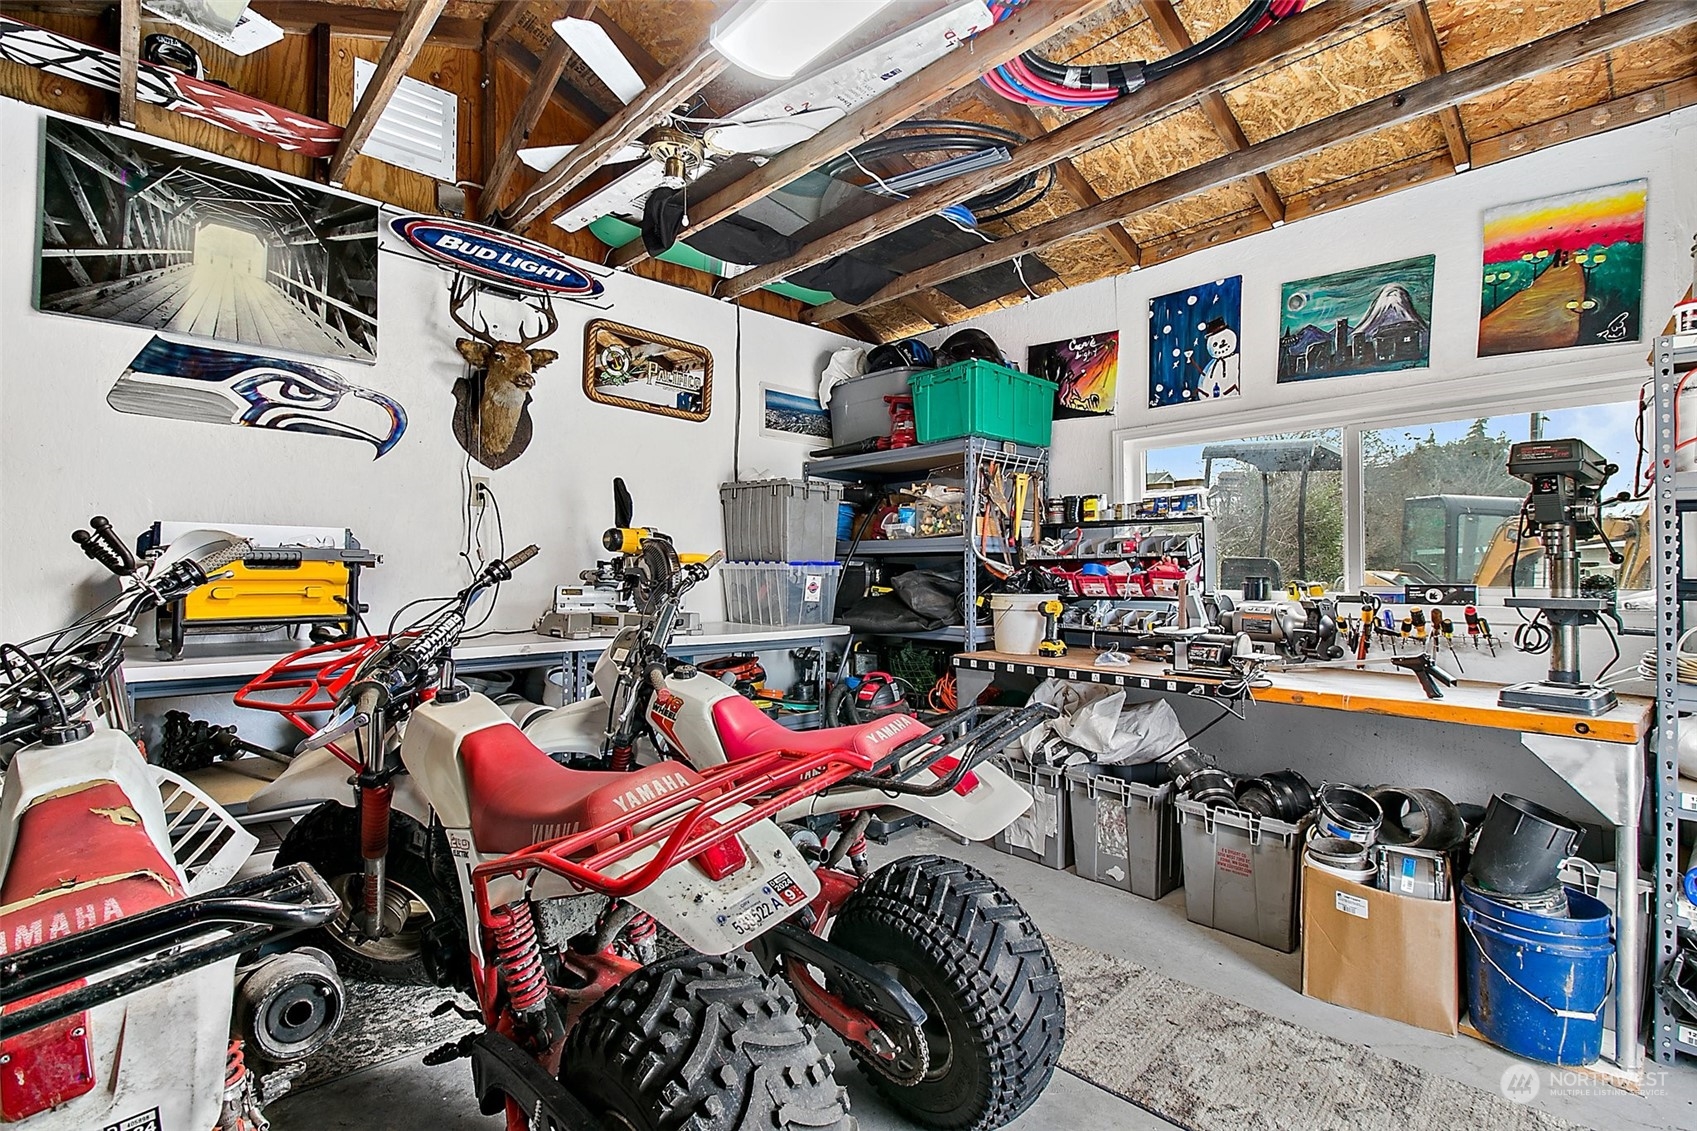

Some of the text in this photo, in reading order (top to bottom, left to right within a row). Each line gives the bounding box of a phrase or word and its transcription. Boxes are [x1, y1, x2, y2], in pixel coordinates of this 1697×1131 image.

[436, 235, 570, 281] BUD LIGHT
[414, 612, 463, 654] RENTHAL
[652, 701, 677, 721] WHEEL
[866, 716, 912, 744] YAMAHA
[612, 772, 690, 812] YAMAHA
[532, 821, 580, 845] YAMAHA
[773, 878, 793, 892] 2024
[784, 889, 796, 901] 9
[770, 897, 784, 911] A
